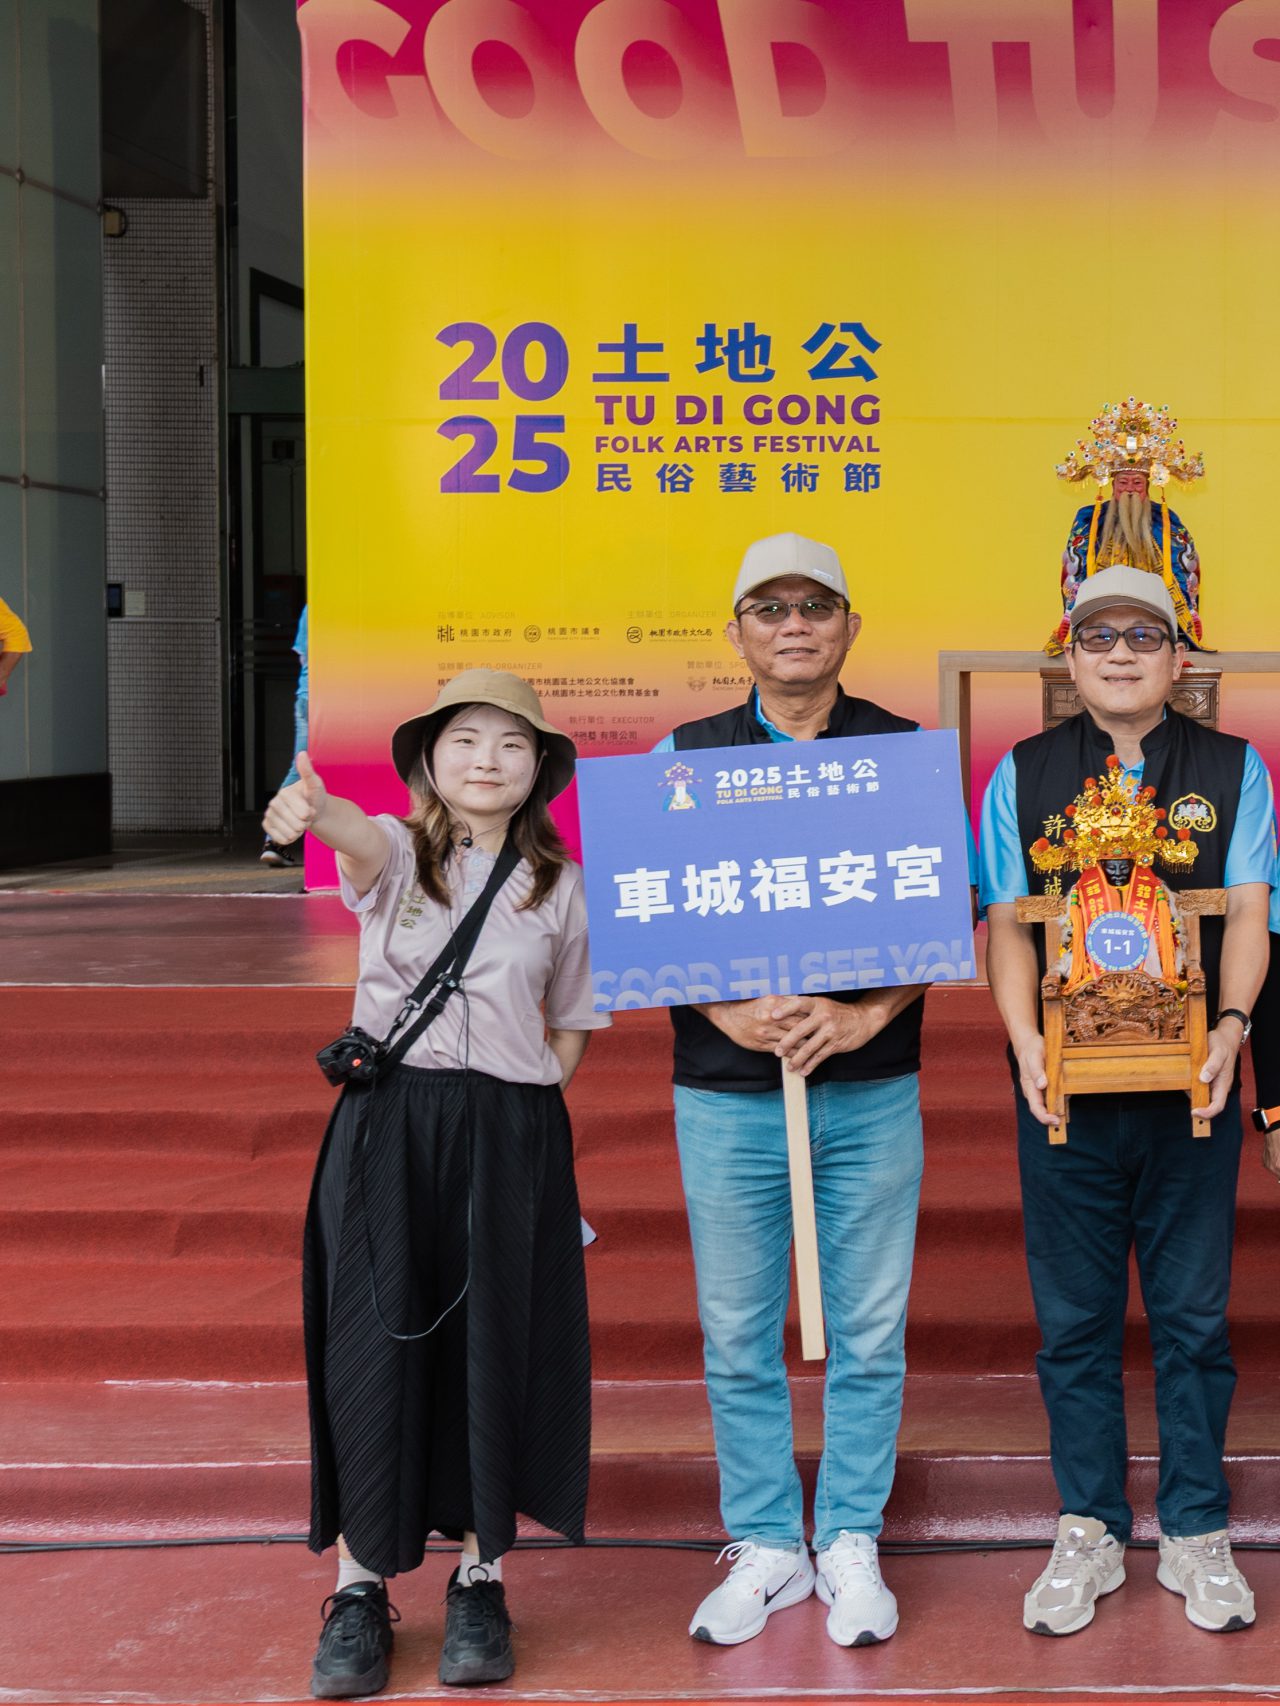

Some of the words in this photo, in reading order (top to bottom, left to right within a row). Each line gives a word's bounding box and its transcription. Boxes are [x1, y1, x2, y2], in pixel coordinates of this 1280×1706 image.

[301, 0, 858, 162] GOOD
[904, 0, 1159, 158] TU
[435, 321, 570, 402] 20
[592, 321, 883, 384] 土地公
[594, 394, 656, 426] TU
[676, 394, 723, 426] DI
[743, 394, 882, 427] GONG
[437, 414, 572, 494] 25
[594, 435, 665, 454] FOLK
[673, 435, 745, 454] ARTS
[753, 435, 881, 454] FESTIVAL
[596, 462, 883, 494] 民俗藝術節
[716, 788, 732, 799] TU
[735, 787, 748, 797] DI
[750, 785, 784, 796] GONG
[787, 781, 880, 799] 民俗藝術節
[613, 844, 943, 924] 車城福安宮
[1103, 939, 1131, 955] 1-1
